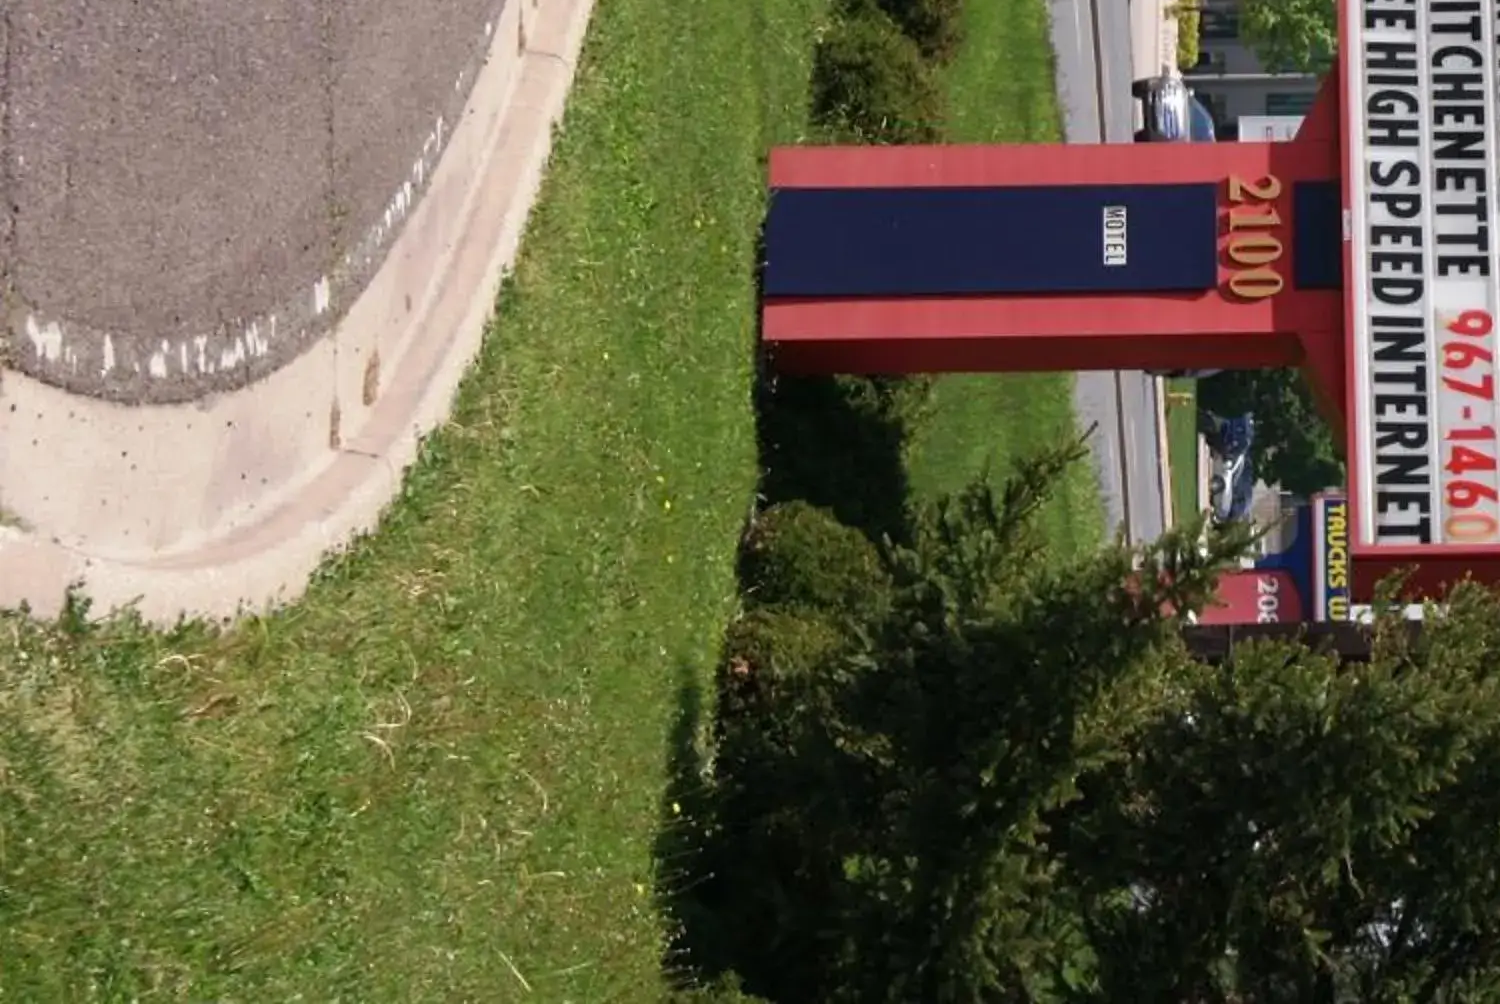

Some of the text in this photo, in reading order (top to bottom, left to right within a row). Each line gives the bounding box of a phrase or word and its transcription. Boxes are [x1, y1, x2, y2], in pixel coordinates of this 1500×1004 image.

[1366, 42, 1420, 146] HIGH
[1105, 208, 1125, 263] MOTEL
[1228, 174, 1284, 298] 2100
[1370, 160, 1424, 305] SPEED
[1371, 316, 1431, 544] INTERNET
[1441, 309, 1500, 541] 967-1460
[1327, 504, 1347, 590] TRUCKS
